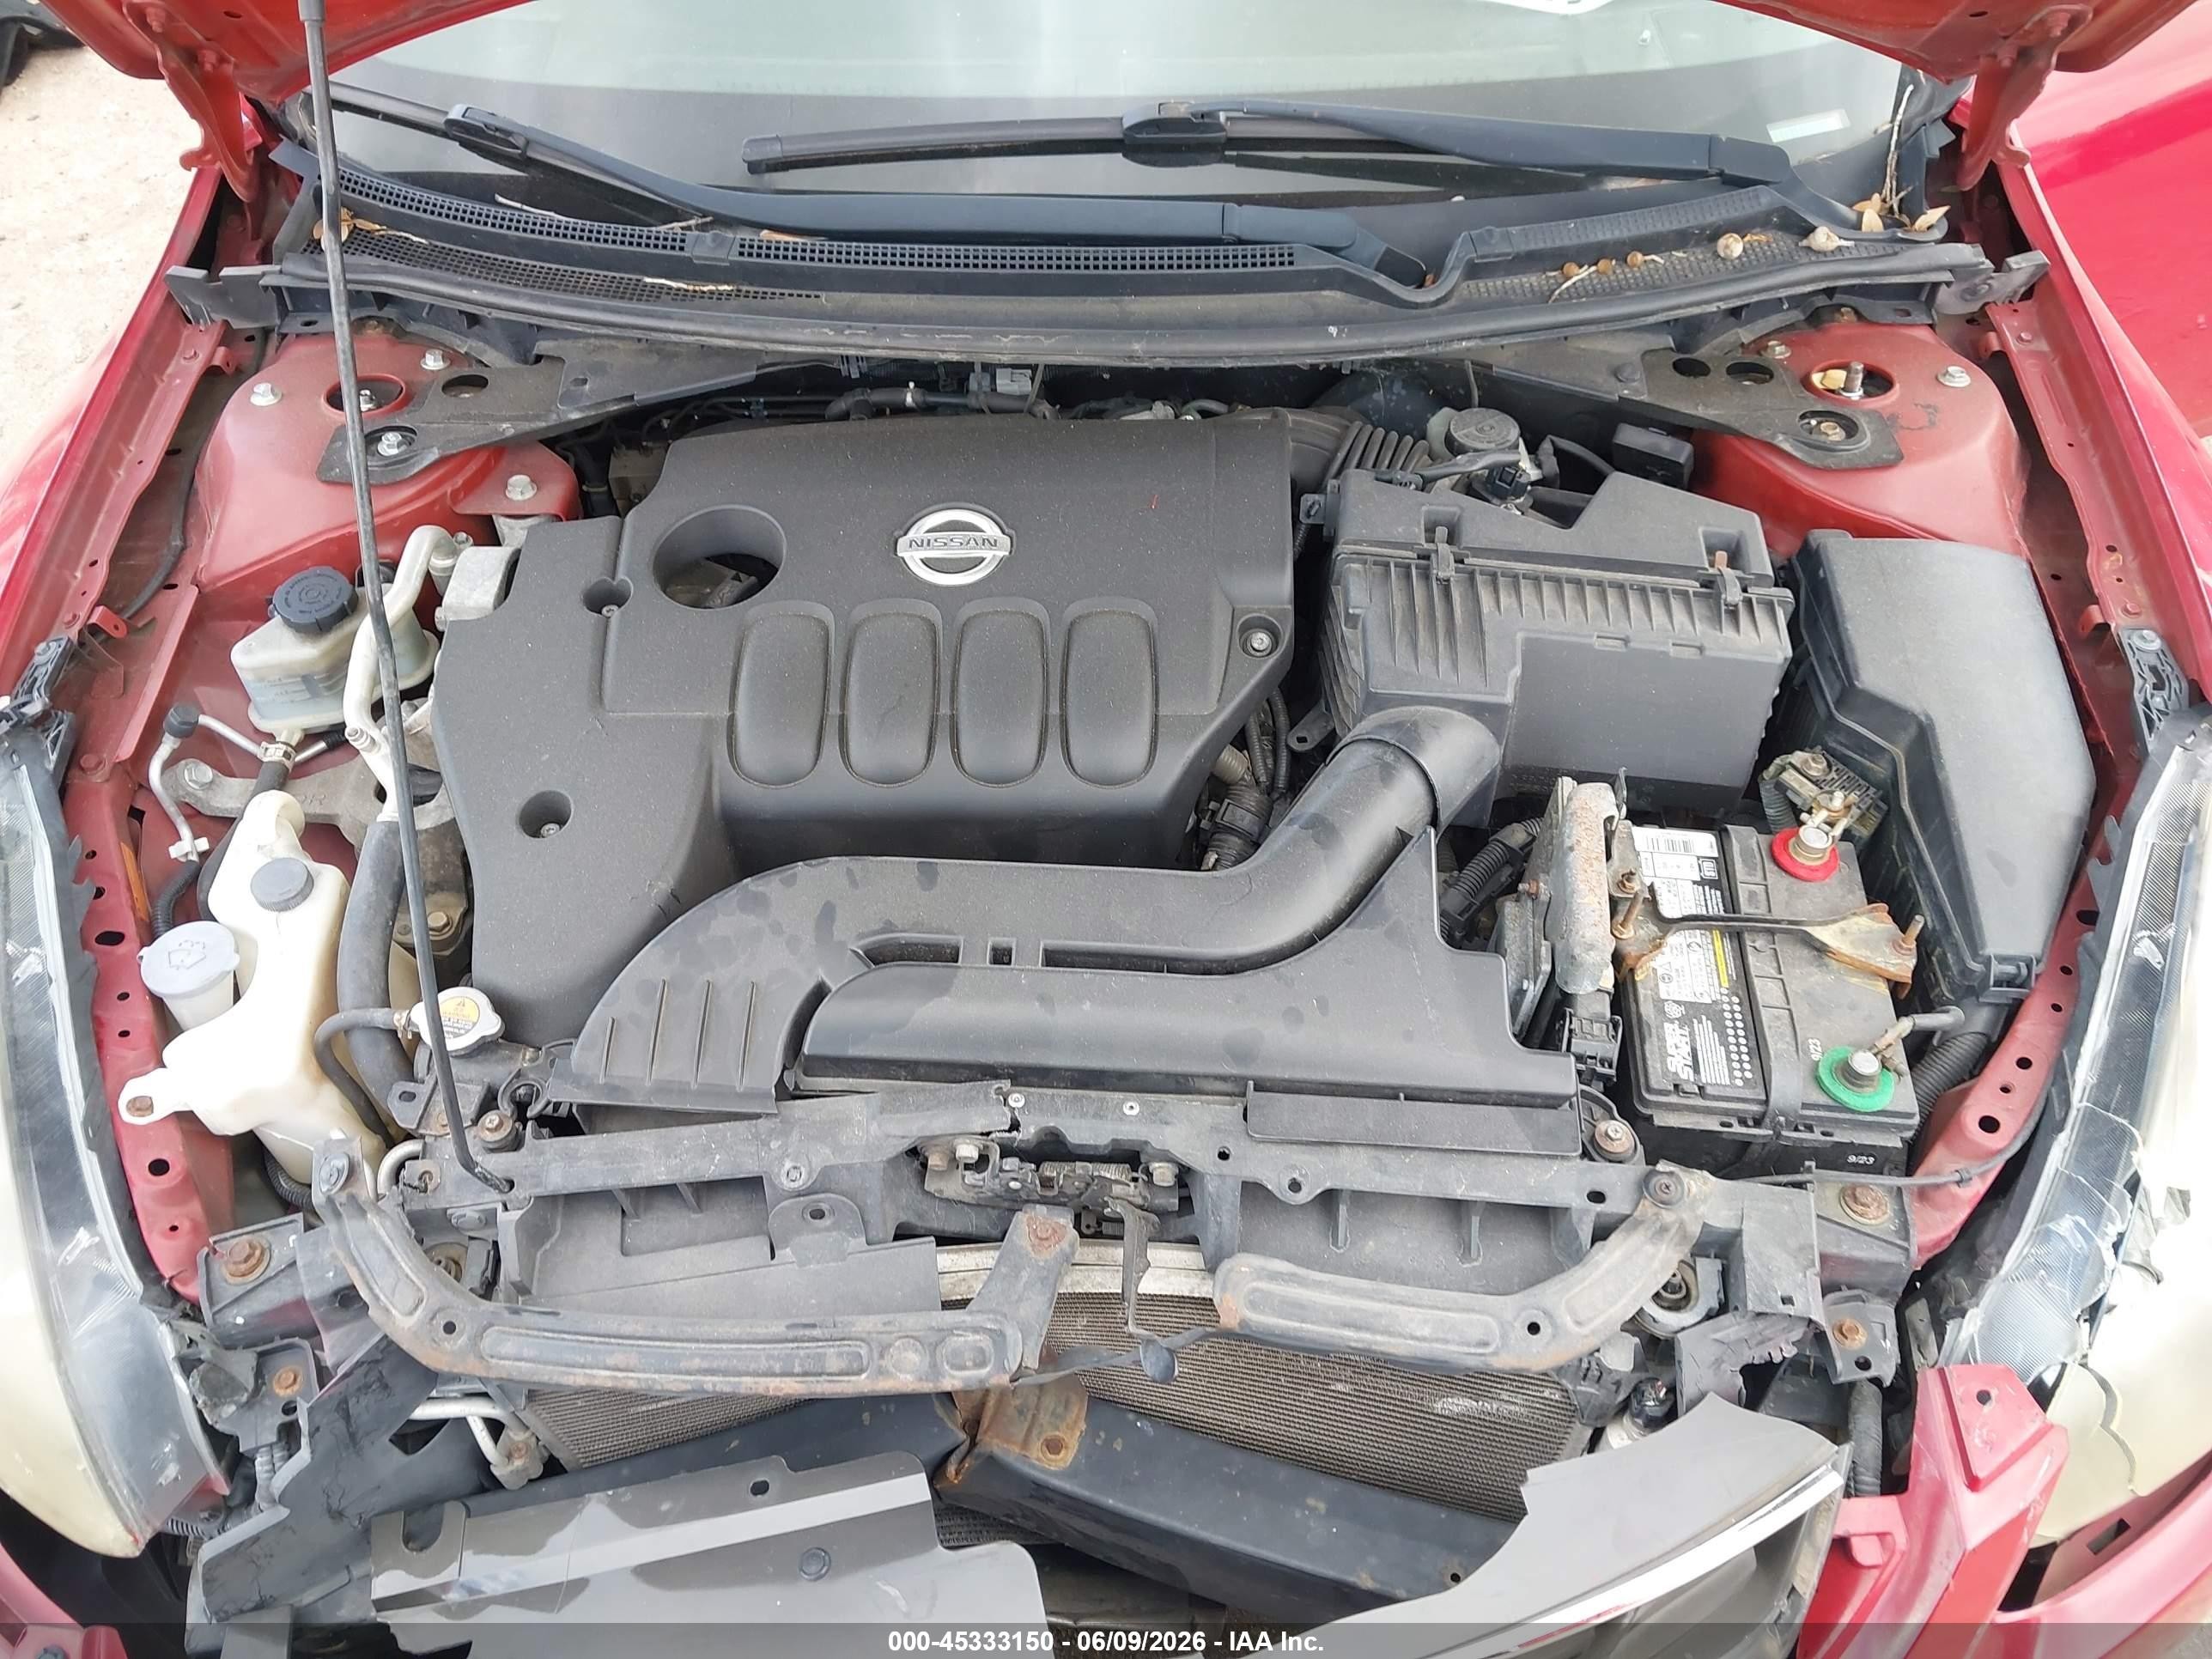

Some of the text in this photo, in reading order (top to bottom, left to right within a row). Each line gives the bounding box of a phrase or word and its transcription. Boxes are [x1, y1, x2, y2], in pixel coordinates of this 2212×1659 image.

[908, 536, 998, 549] NISSAN
[1663, 1022, 1679, 1073] SUPER
[1674, 1027, 1694, 1082] START
[1808, 1038, 1822, 1061] 9/23
[1846, 1154, 1875, 1165] 9/23
